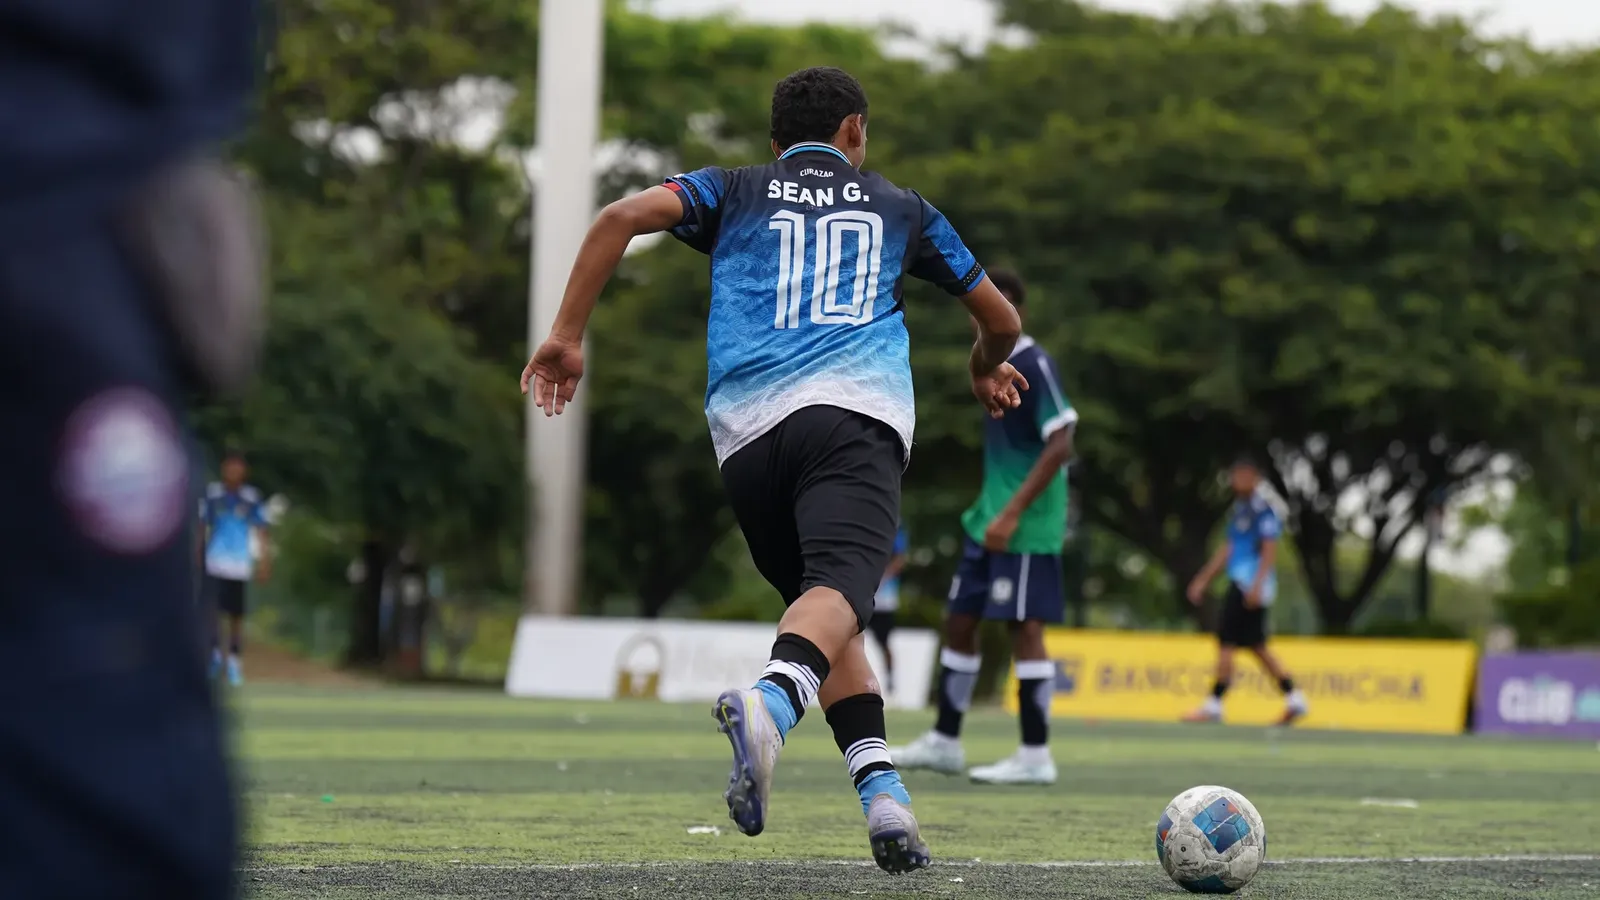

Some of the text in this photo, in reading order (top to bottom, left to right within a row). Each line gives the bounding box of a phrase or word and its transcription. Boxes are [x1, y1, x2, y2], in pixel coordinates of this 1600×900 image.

[767, 179, 870, 207] SEAN G.
[768, 209, 883, 329] 10
